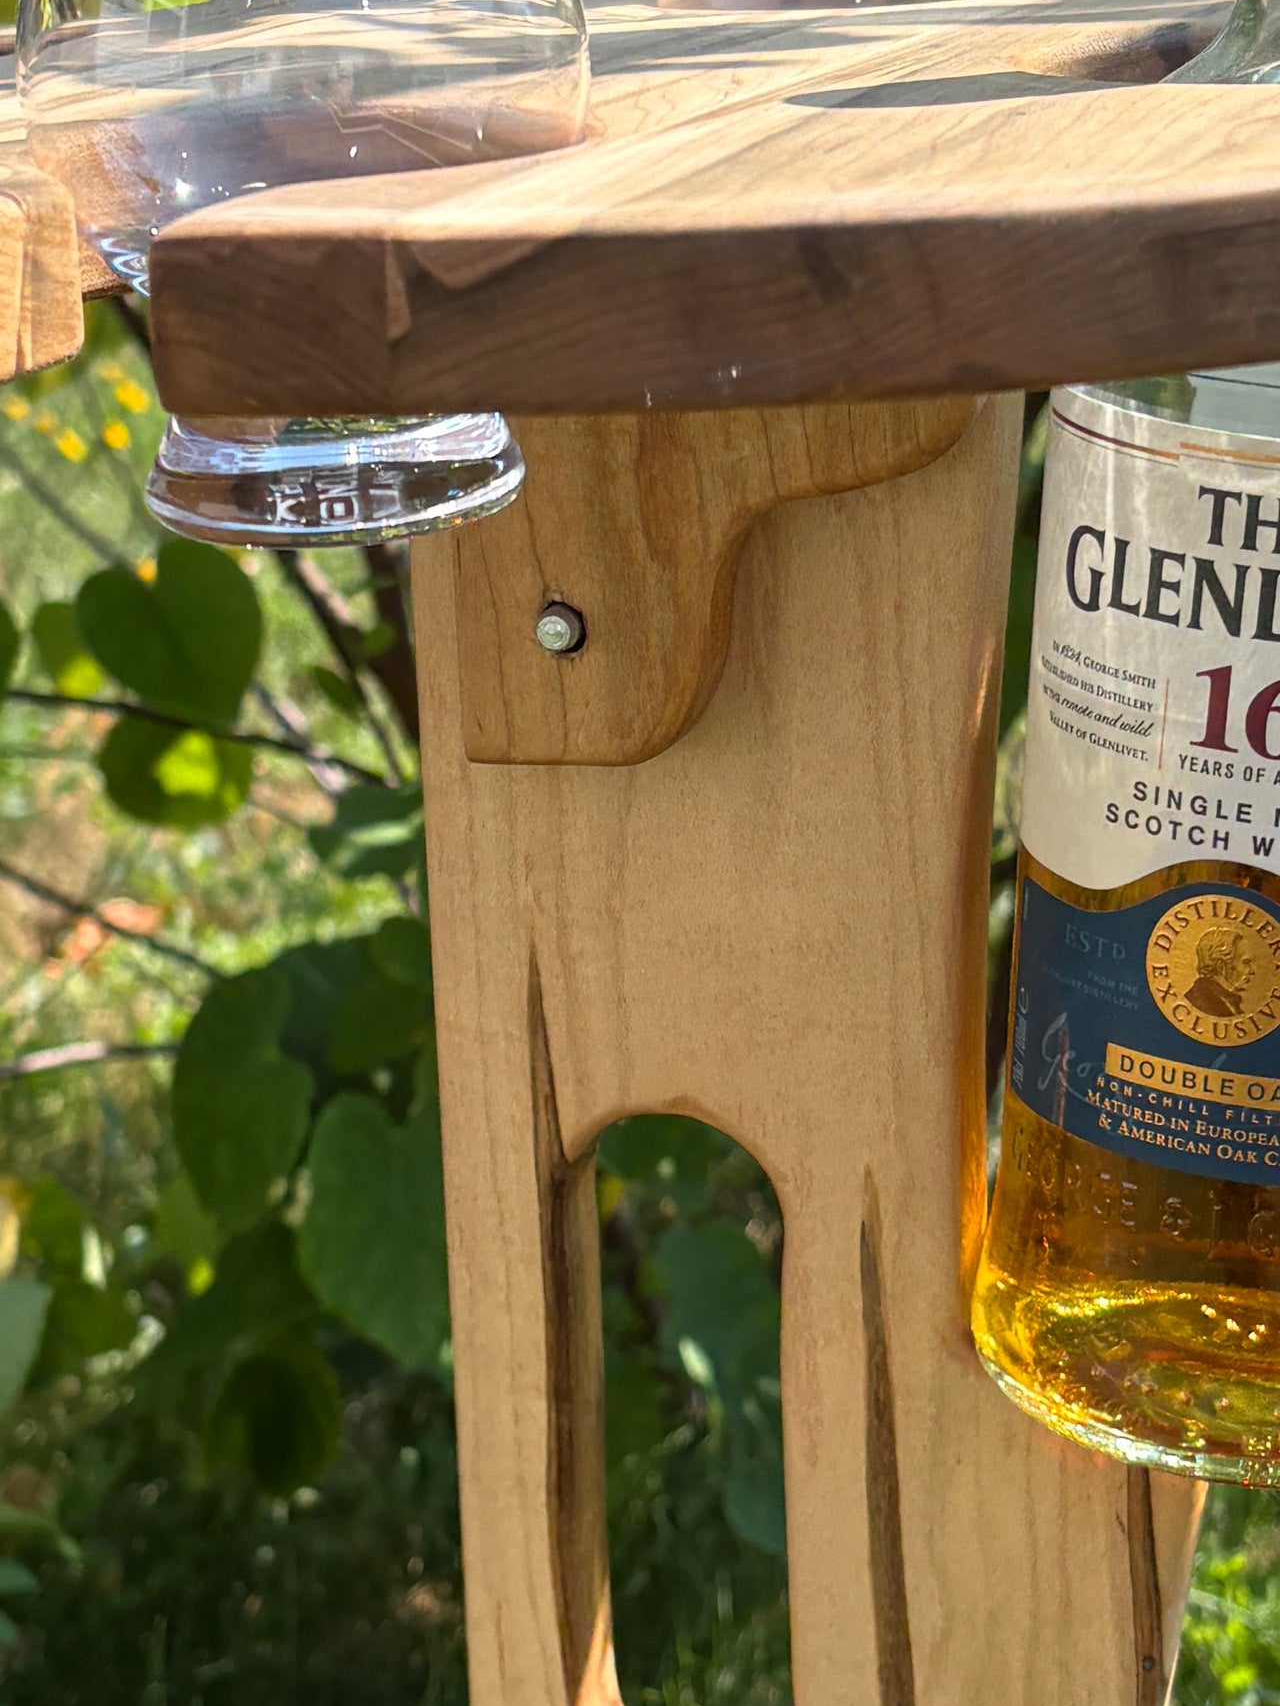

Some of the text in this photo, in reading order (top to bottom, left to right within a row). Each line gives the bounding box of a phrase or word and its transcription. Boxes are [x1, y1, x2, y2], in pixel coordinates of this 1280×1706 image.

[1096, 685, 1154, 713] DISTILLERY
[1121, 670, 1156, 690] SMITH
[1094, 713, 1123, 729] and
[1120, 719, 1155, 738] wild
[1089, 732, 1149, 762] GLENLIVET.
[1178, 754, 1235, 780] YEARS
[1243, 765, 1266, 783] OF
[1132, 781, 1253, 824] SINGLE
[1105, 803, 1230, 851] SCOTCH
[1065, 924, 1126, 960] ESTD
[1120, 1054, 1235, 1096] DOUBLE
[1086, 1089, 1166, 1126] MATURED
[1170, 1116, 1189, 1132] IN
[1096, 1076, 1209, 1116] NON-CHILL
[1098, 1113, 1112, 1131] &
[1117, 1122, 1211, 1156] AMERICAN
[1216, 1144, 1258, 1164] OAK
